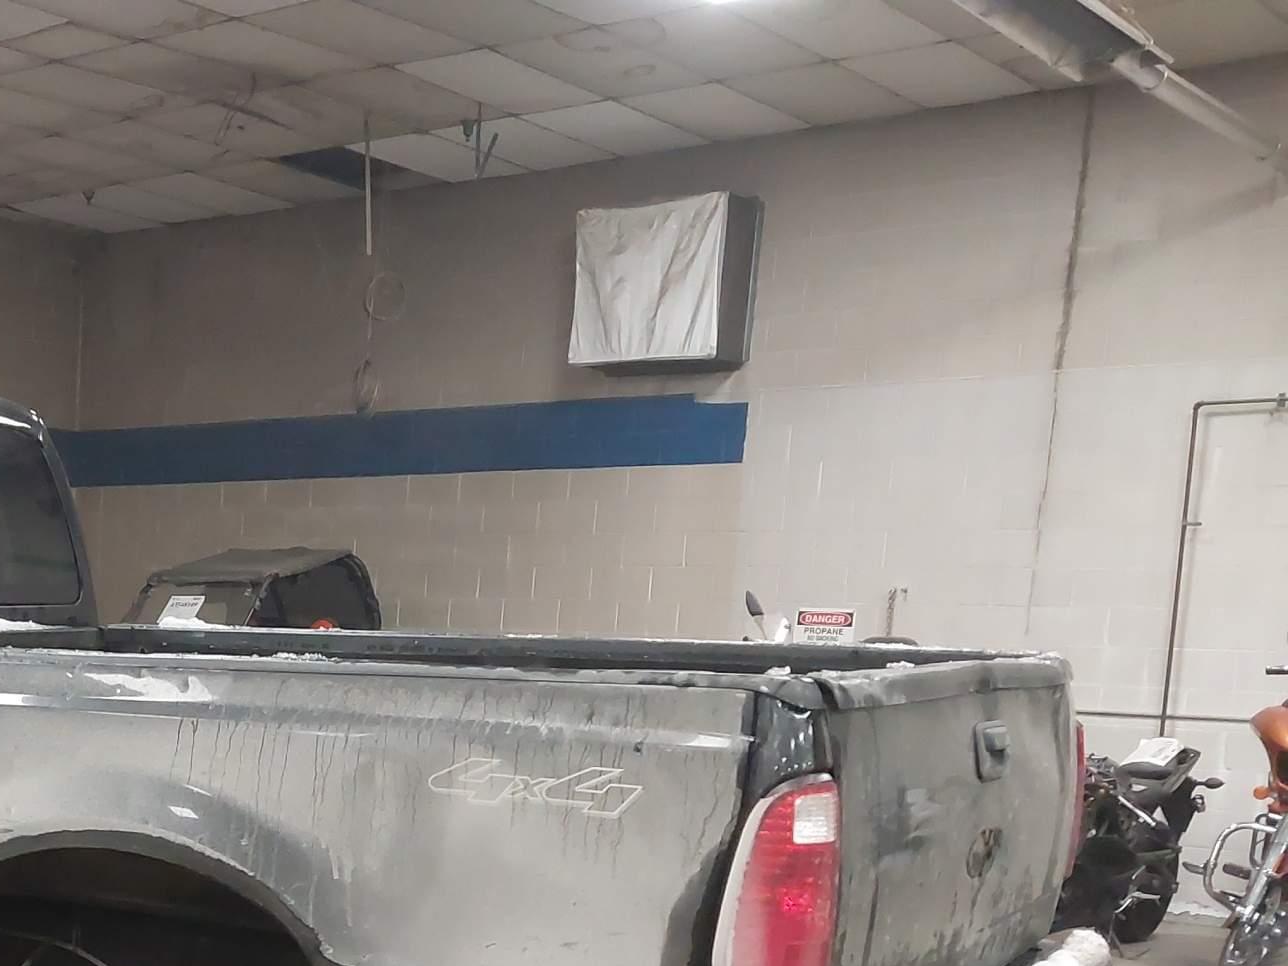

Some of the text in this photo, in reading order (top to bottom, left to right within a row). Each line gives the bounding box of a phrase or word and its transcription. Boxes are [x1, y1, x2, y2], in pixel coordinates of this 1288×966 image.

[805, 614, 845, 624] DANGER
[804, 627, 844, 635] PROPANE
[428, 758, 643, 819] 4x4
